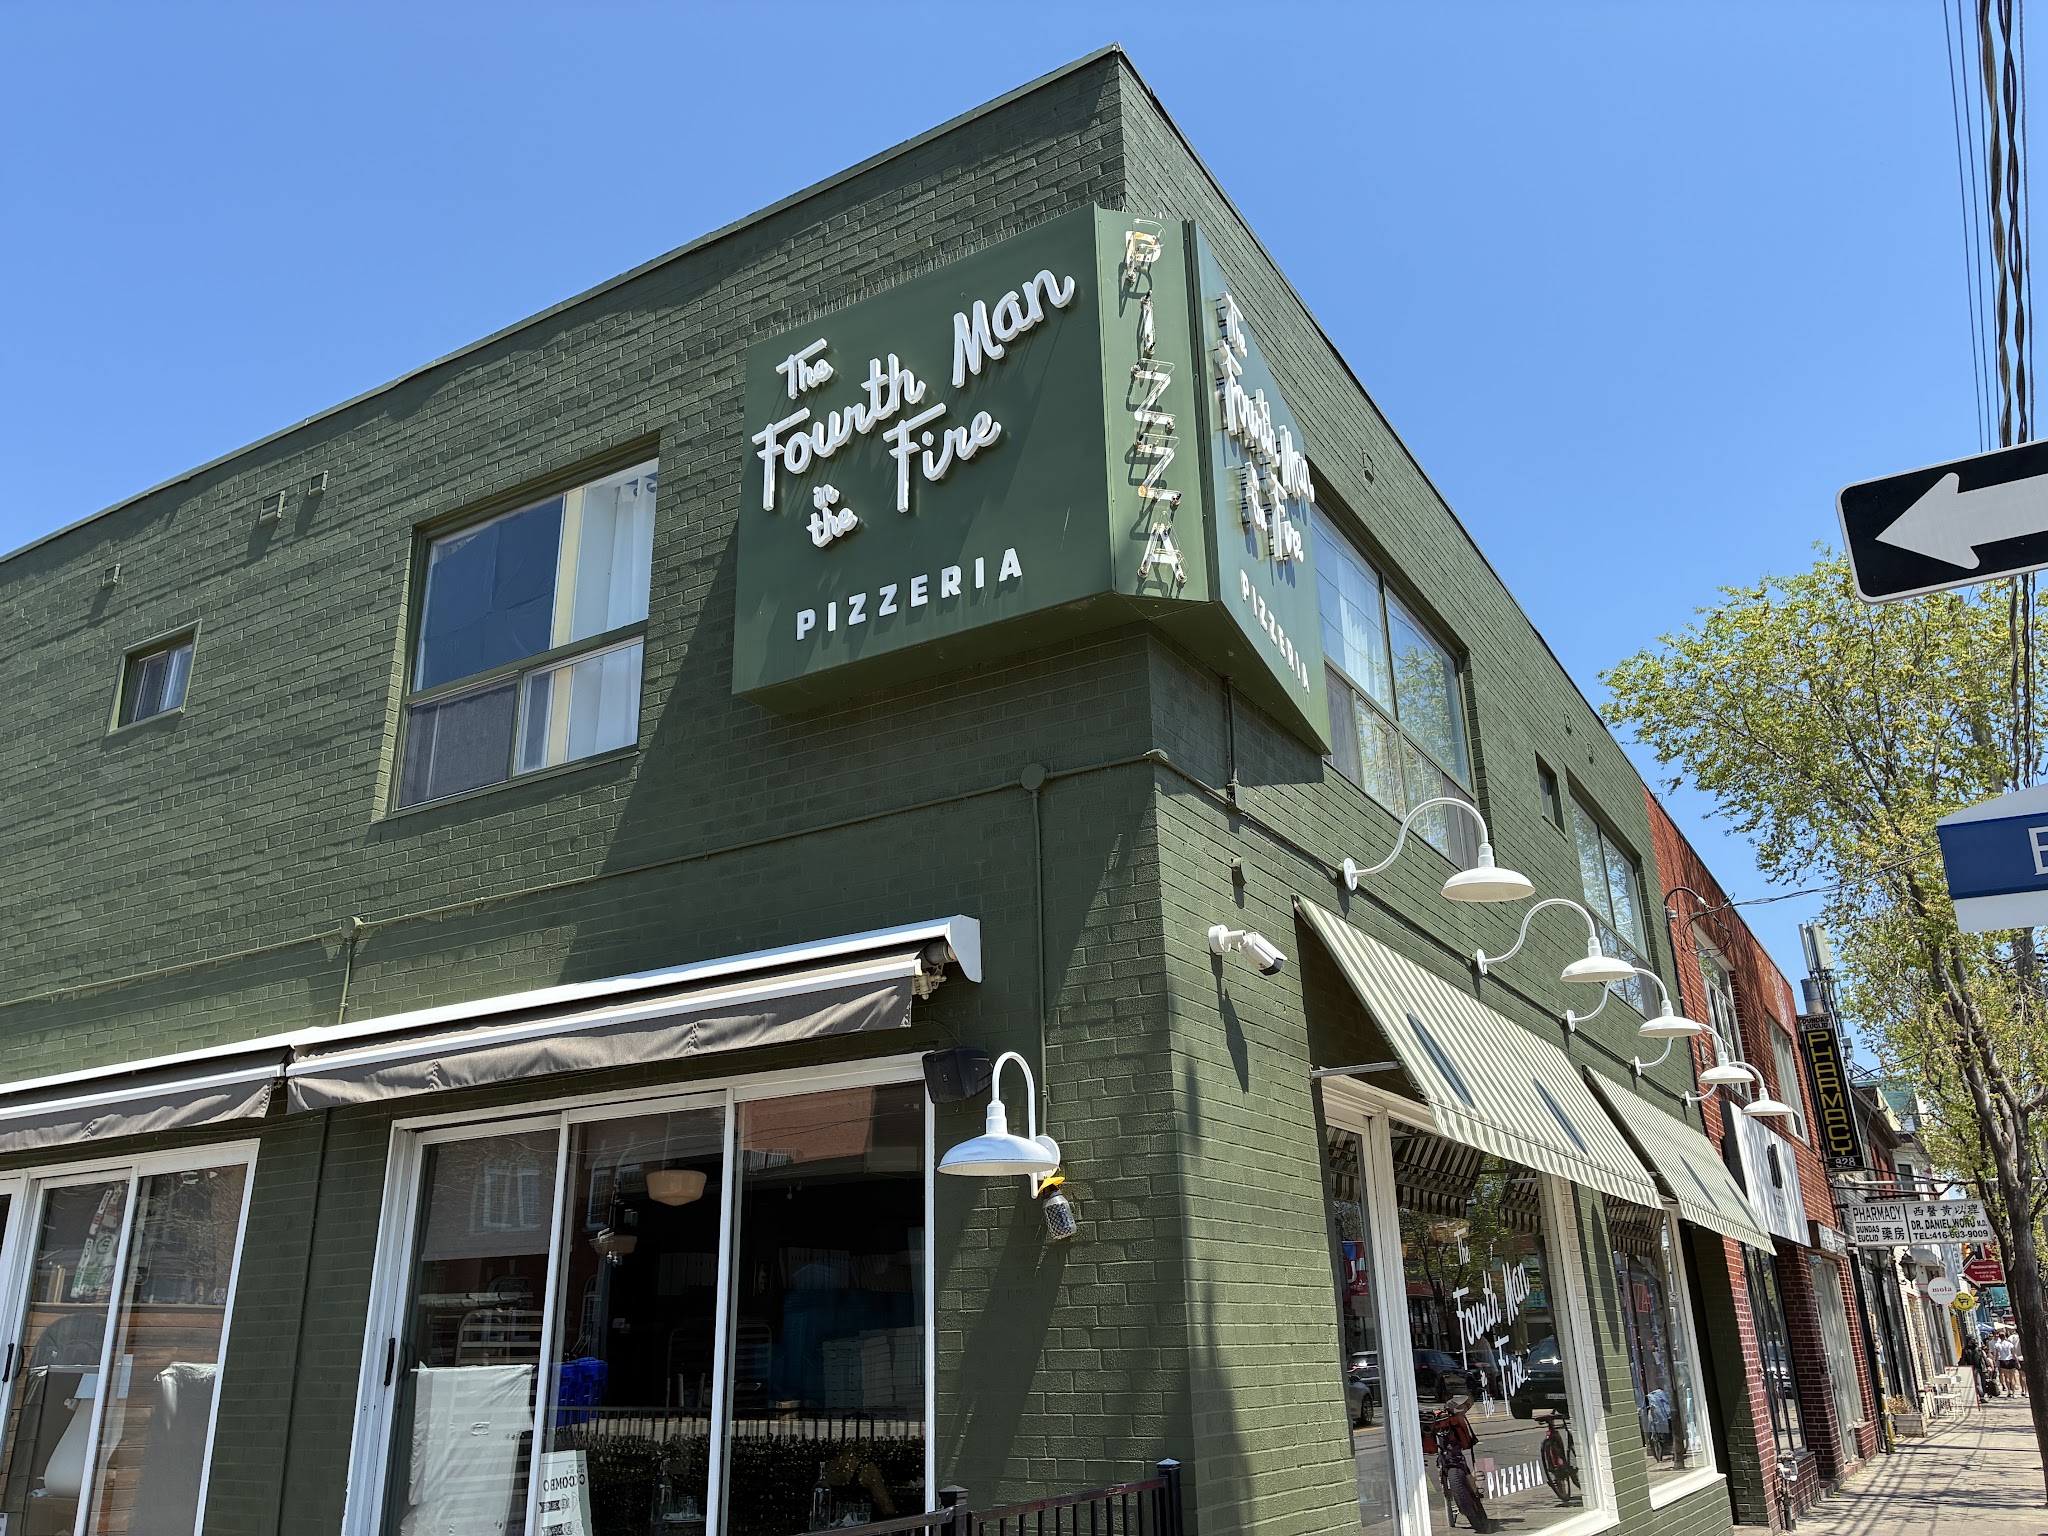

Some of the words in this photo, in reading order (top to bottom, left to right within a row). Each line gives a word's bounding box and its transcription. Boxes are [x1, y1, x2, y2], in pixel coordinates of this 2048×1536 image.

[775, 337, 834, 400] The
[751, 352, 927, 512] Fourth
[951, 269, 1076, 389] Man
[1125, 218, 1189, 584] PIZZA
[882, 402, 1002, 514] Fire
[812, 484, 840, 510] in
[805, 506, 859, 548] the
[796, 547, 1023, 641] PIZZERIA
[1240, 568, 1310, 694] PIZZERIA
[1802, 1016, 1829, 1025] DUNDAS
[1807, 1031, 1853, 1156] PHARMACY
[1853, 1206, 1901, 1220] PHARMACY
[1856, 1225, 1880, 1233] DUNDAS
[1911, 1220, 1924, 1230] DR.
[1925, 1219, 1950, 1229] DANIEL
[1453, 1227, 1471, 1266] The
[1858, 1234, 1879, 1242] EUCLID
[1452, 1270, 1501, 1370] Fourth
[1502, 1261, 1530, 1327] Man
[1494, 1335, 1528, 1416] Fire
[1482, 1390, 1495, 1419] the
[1486, 1459, 1543, 1500] PIZZERIA
